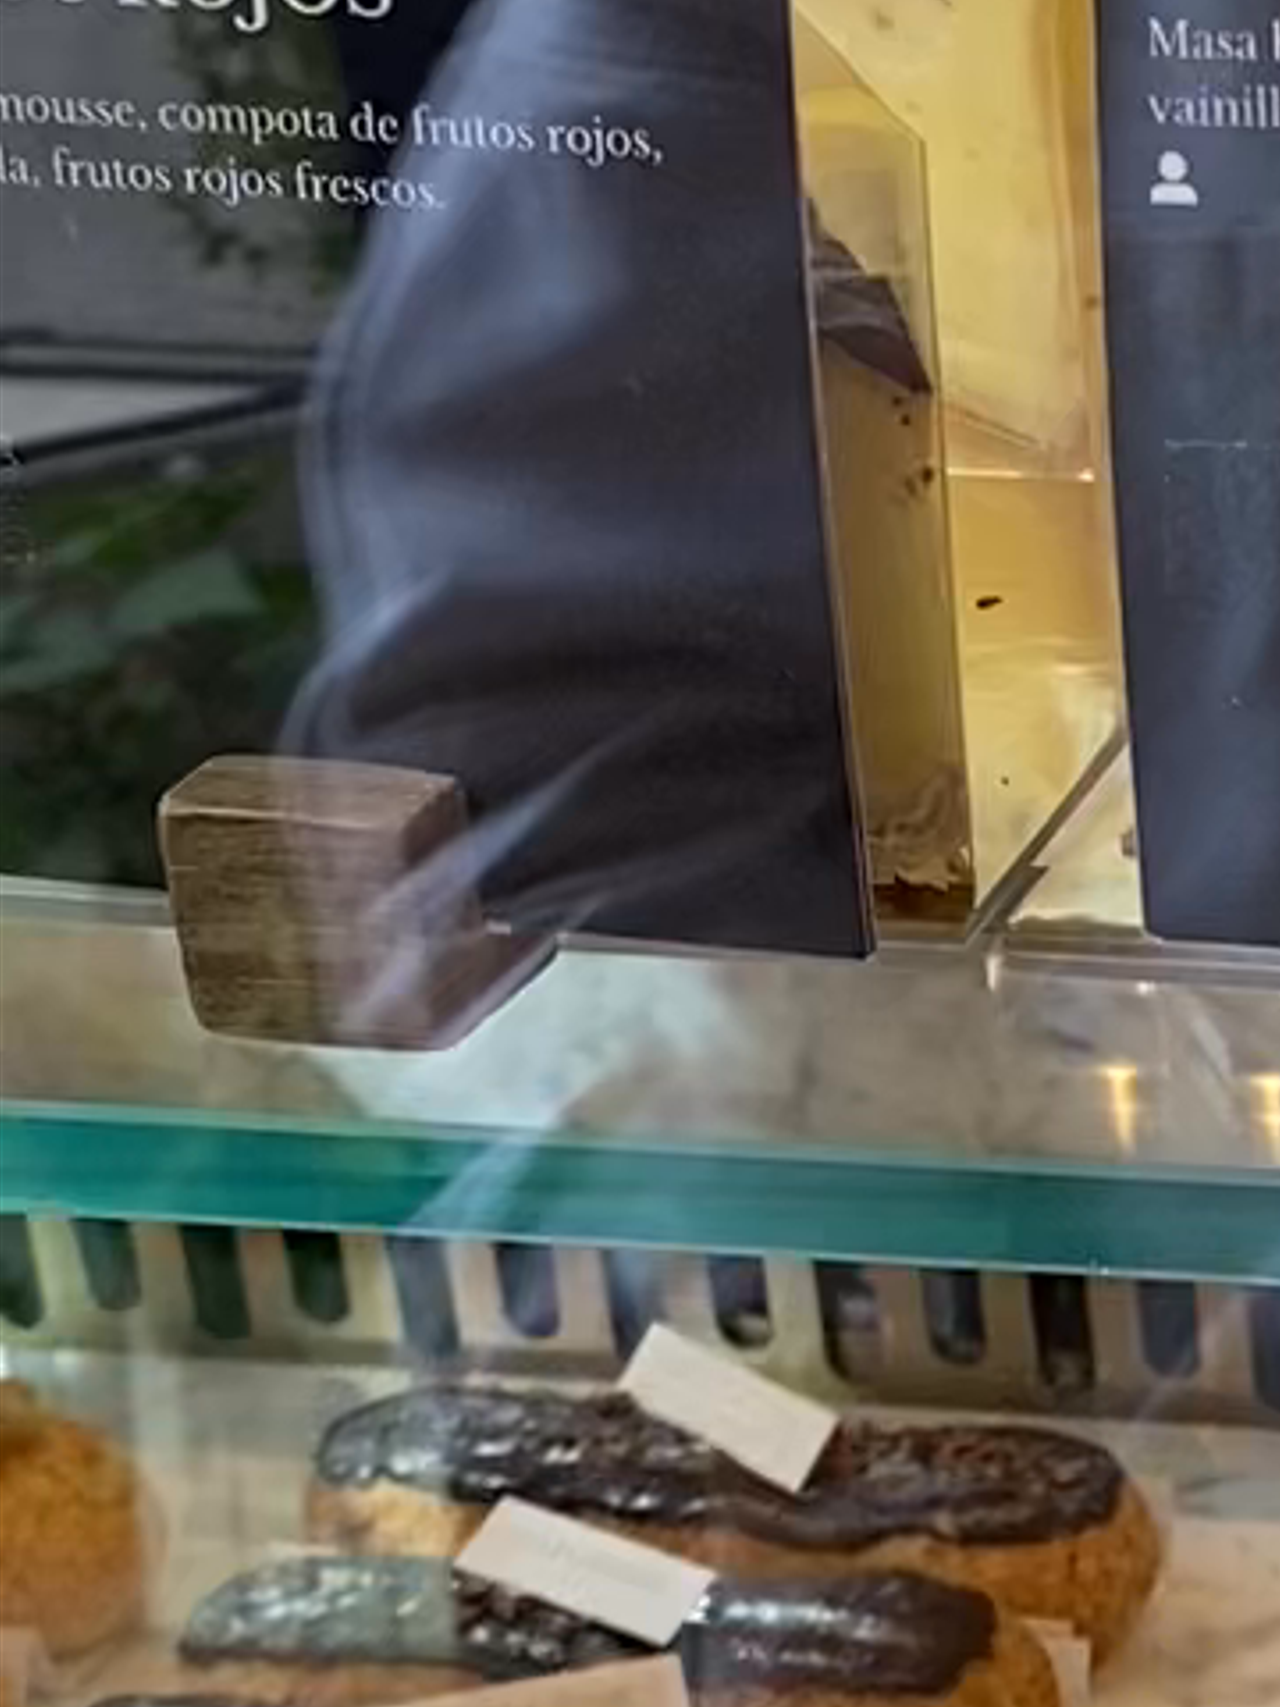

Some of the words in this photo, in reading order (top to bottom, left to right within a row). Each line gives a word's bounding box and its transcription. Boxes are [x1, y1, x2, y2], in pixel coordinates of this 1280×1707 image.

[1148, 16, 1258, 62] Masa
[158, 101, 340, 146] compota
[350, 101, 399, 143] de
[412, 102, 536, 152] frutos
[548, 115, 664, 167] rojos,
[52, 145, 174, 192] frutos
[185, 155, 284, 208] rojos
[295, 160, 447, 210] frescos.
